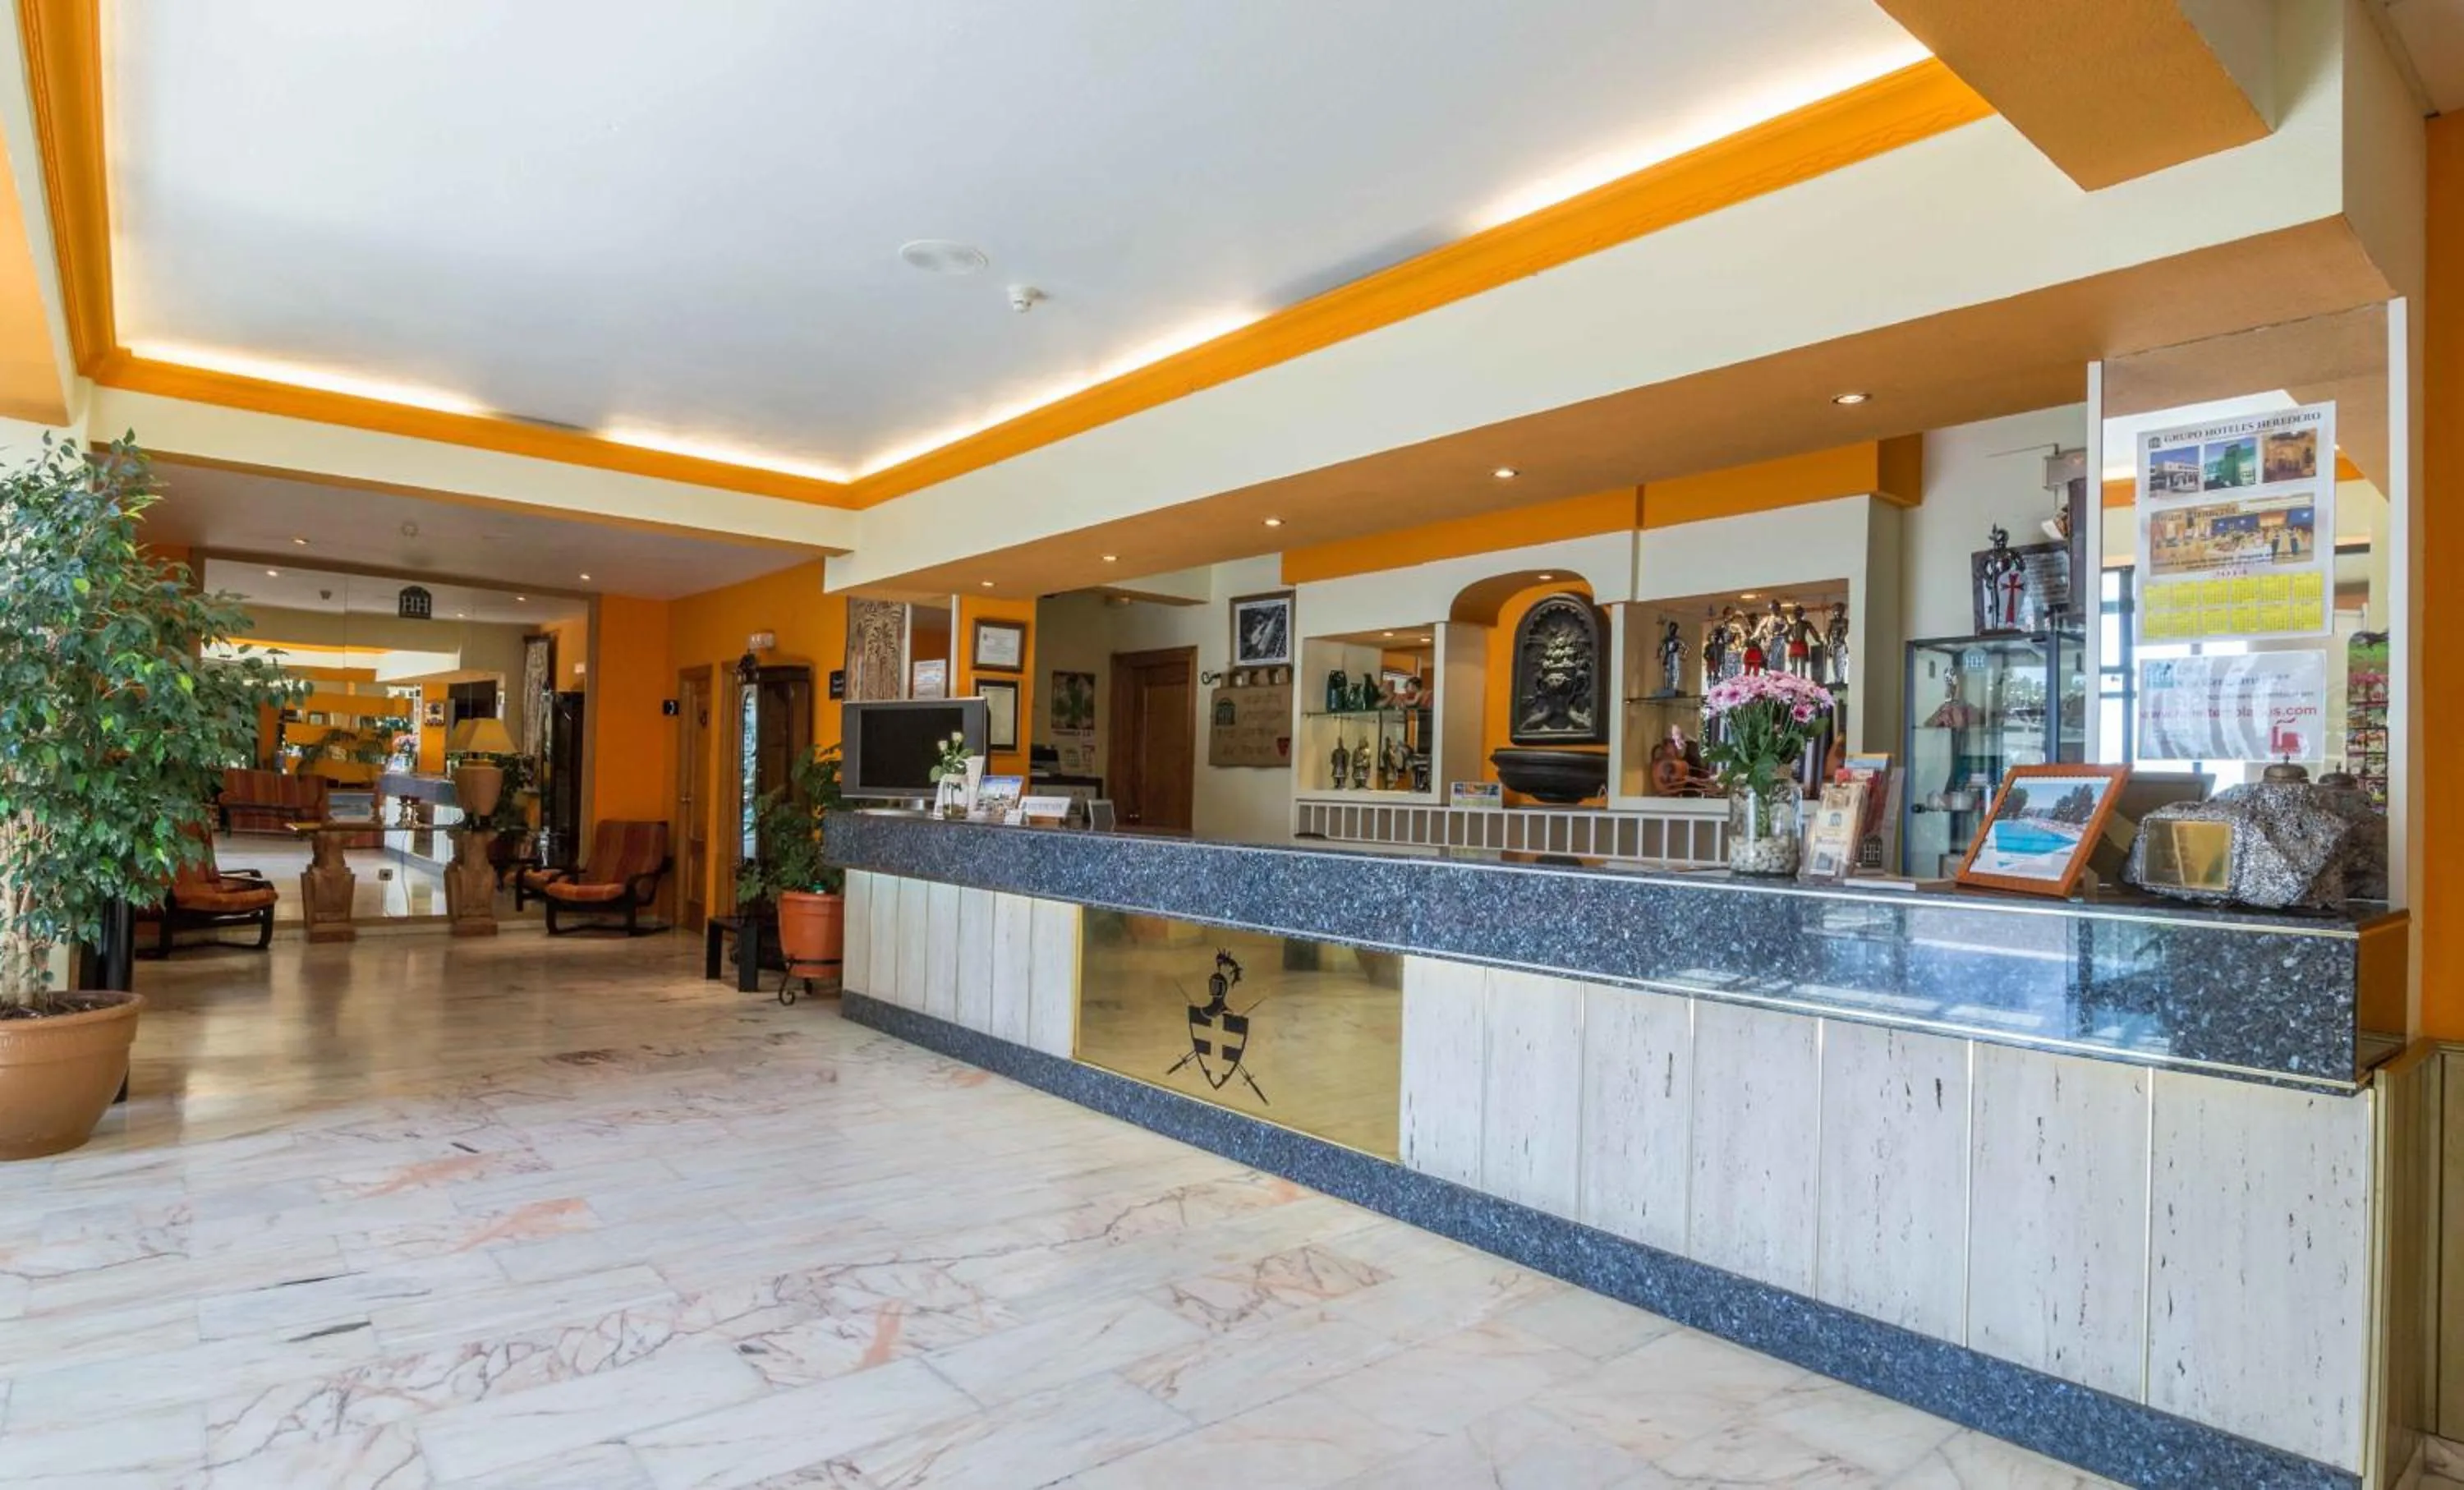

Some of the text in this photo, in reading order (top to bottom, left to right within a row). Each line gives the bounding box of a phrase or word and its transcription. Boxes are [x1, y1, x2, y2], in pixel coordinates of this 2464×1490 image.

[2163, 430, 2203, 443] GRUPO
[2205, 421, 2255, 437] HOTELES
[2257, 412, 2321, 429] HEREDERO
